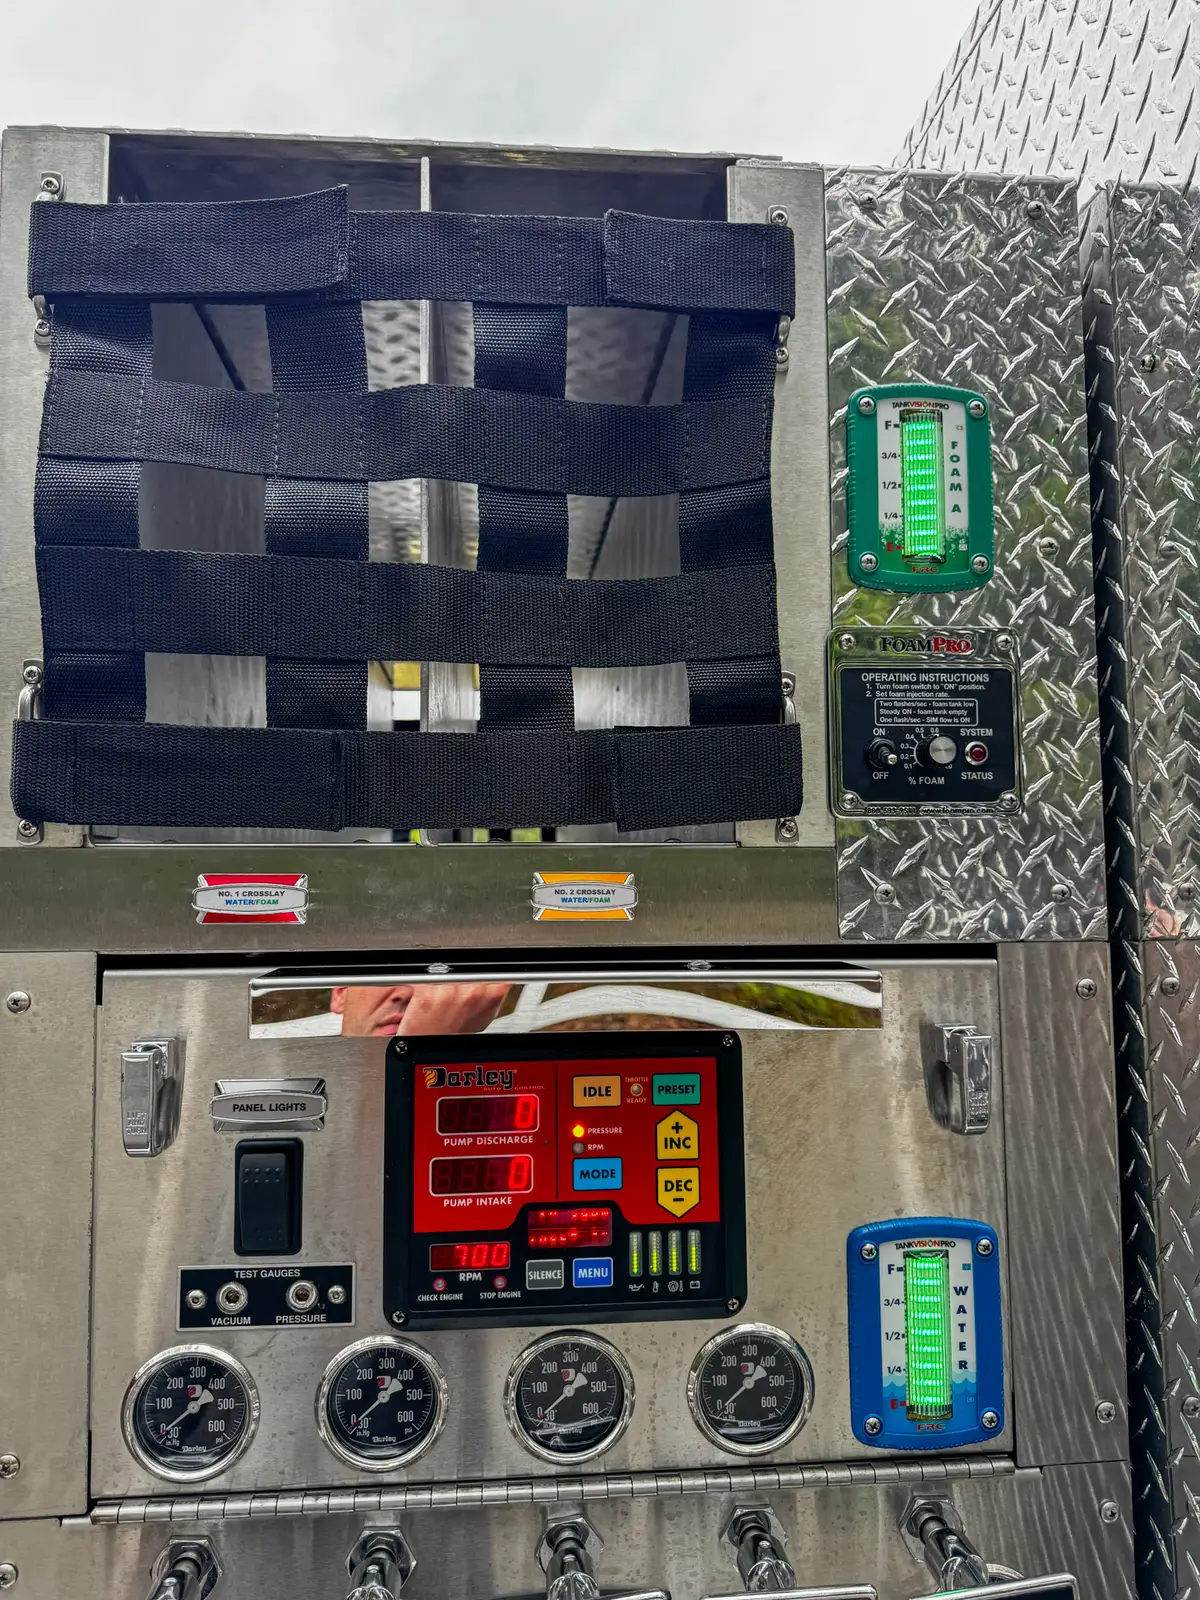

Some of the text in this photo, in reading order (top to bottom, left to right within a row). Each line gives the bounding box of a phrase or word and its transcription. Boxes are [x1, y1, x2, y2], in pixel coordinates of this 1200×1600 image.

[892, 401, 950, 410] TANKVISIONPRO
[881, 452, 898, 460] 3/4
[882, 481, 897, 490] 1/2
[884, 512, 898, 520] 1/4
[861, 672, 990, 683] OPERATING INSTRUCTIONS
[958, 684, 986, 692] position.
[906, 691, 934, 699] injection
[879, 708, 901, 716] Steady
[873, 728, 886, 736] ON
[960, 728, 993, 736] SYSTEM
[872, 771, 889, 780] OFF
[908, 776, 945, 785] % FOAM
[961, 771, 993, 780] STATUS
[423, 1065, 514, 1090] Darley
[583, 1086, 612, 1098] IDLE
[658, 1084, 696, 1095] PRESET
[232, 1102, 307, 1112] PANEL LIGHTS
[587, 1127, 623, 1135] PRESSURE
[444, 1135, 534, 1147] PUMP DISCHARGE
[664, 1136, 691, 1150] INC
[579, 1169, 616, 1180] MODE
[664, 1179, 693, 1192] DEC
[443, 1196, 513, 1208] PUMP INTAKE
[895, 1240, 956, 1251] TANKVISIONPRO
[454, 1243, 509, 1267] 700
[234, 1268, 300, 1279] TEST GAUGES
[459, 1272, 482, 1282] RPM
[528, 1270, 562, 1280] SILENCE
[578, 1267, 608, 1278] MENU
[417, 1292, 464, 1302] CHECK ENGINE
[479, 1290, 522, 1300] STOP ENGINE
[883, 1298, 901, 1307] 3/4
[210, 1316, 251, 1326] VACUUM
[275, 1313, 327, 1324] PRESSURE
[884, 1331, 901, 1341] 1/2
[562, 1350, 579, 1362] 300
[742, 1345, 758, 1356] 300
[379, 1357, 395, 1369] 300
[721, 1355, 737, 1367] 200
[760, 1356, 776, 1367] 400
[189, 1366, 206, 1378] 300
[541, 1362, 558, 1374] 200
[581, 1362, 598, 1373] 400
[887, 1366, 902, 1374] 1/4
[356, 1368, 373, 1380] 200
[397, 1369, 414, 1380] 400
[166, 1377, 184, 1390] 200
[208, 1378, 225, 1390] 400
[712, 1375, 728, 1386] 100
[769, 1375, 785, 1386] 500
[531, 1382, 548, 1393] 100
[590, 1381, 607, 1393] 500
[346, 1389, 362, 1400] 100
[406, 1389, 423, 1401] 500
[156, 1397, 172, 1409] 100
[217, 1398, 234, 1410] 500
[761, 1396, 777, 1407] 600
[582, 1402, 599, 1414] 600
[397, 1411, 414, 1422] 600
[208, 1420, 225, 1432] 600
[917, 1423, 945, 1431] FRC
